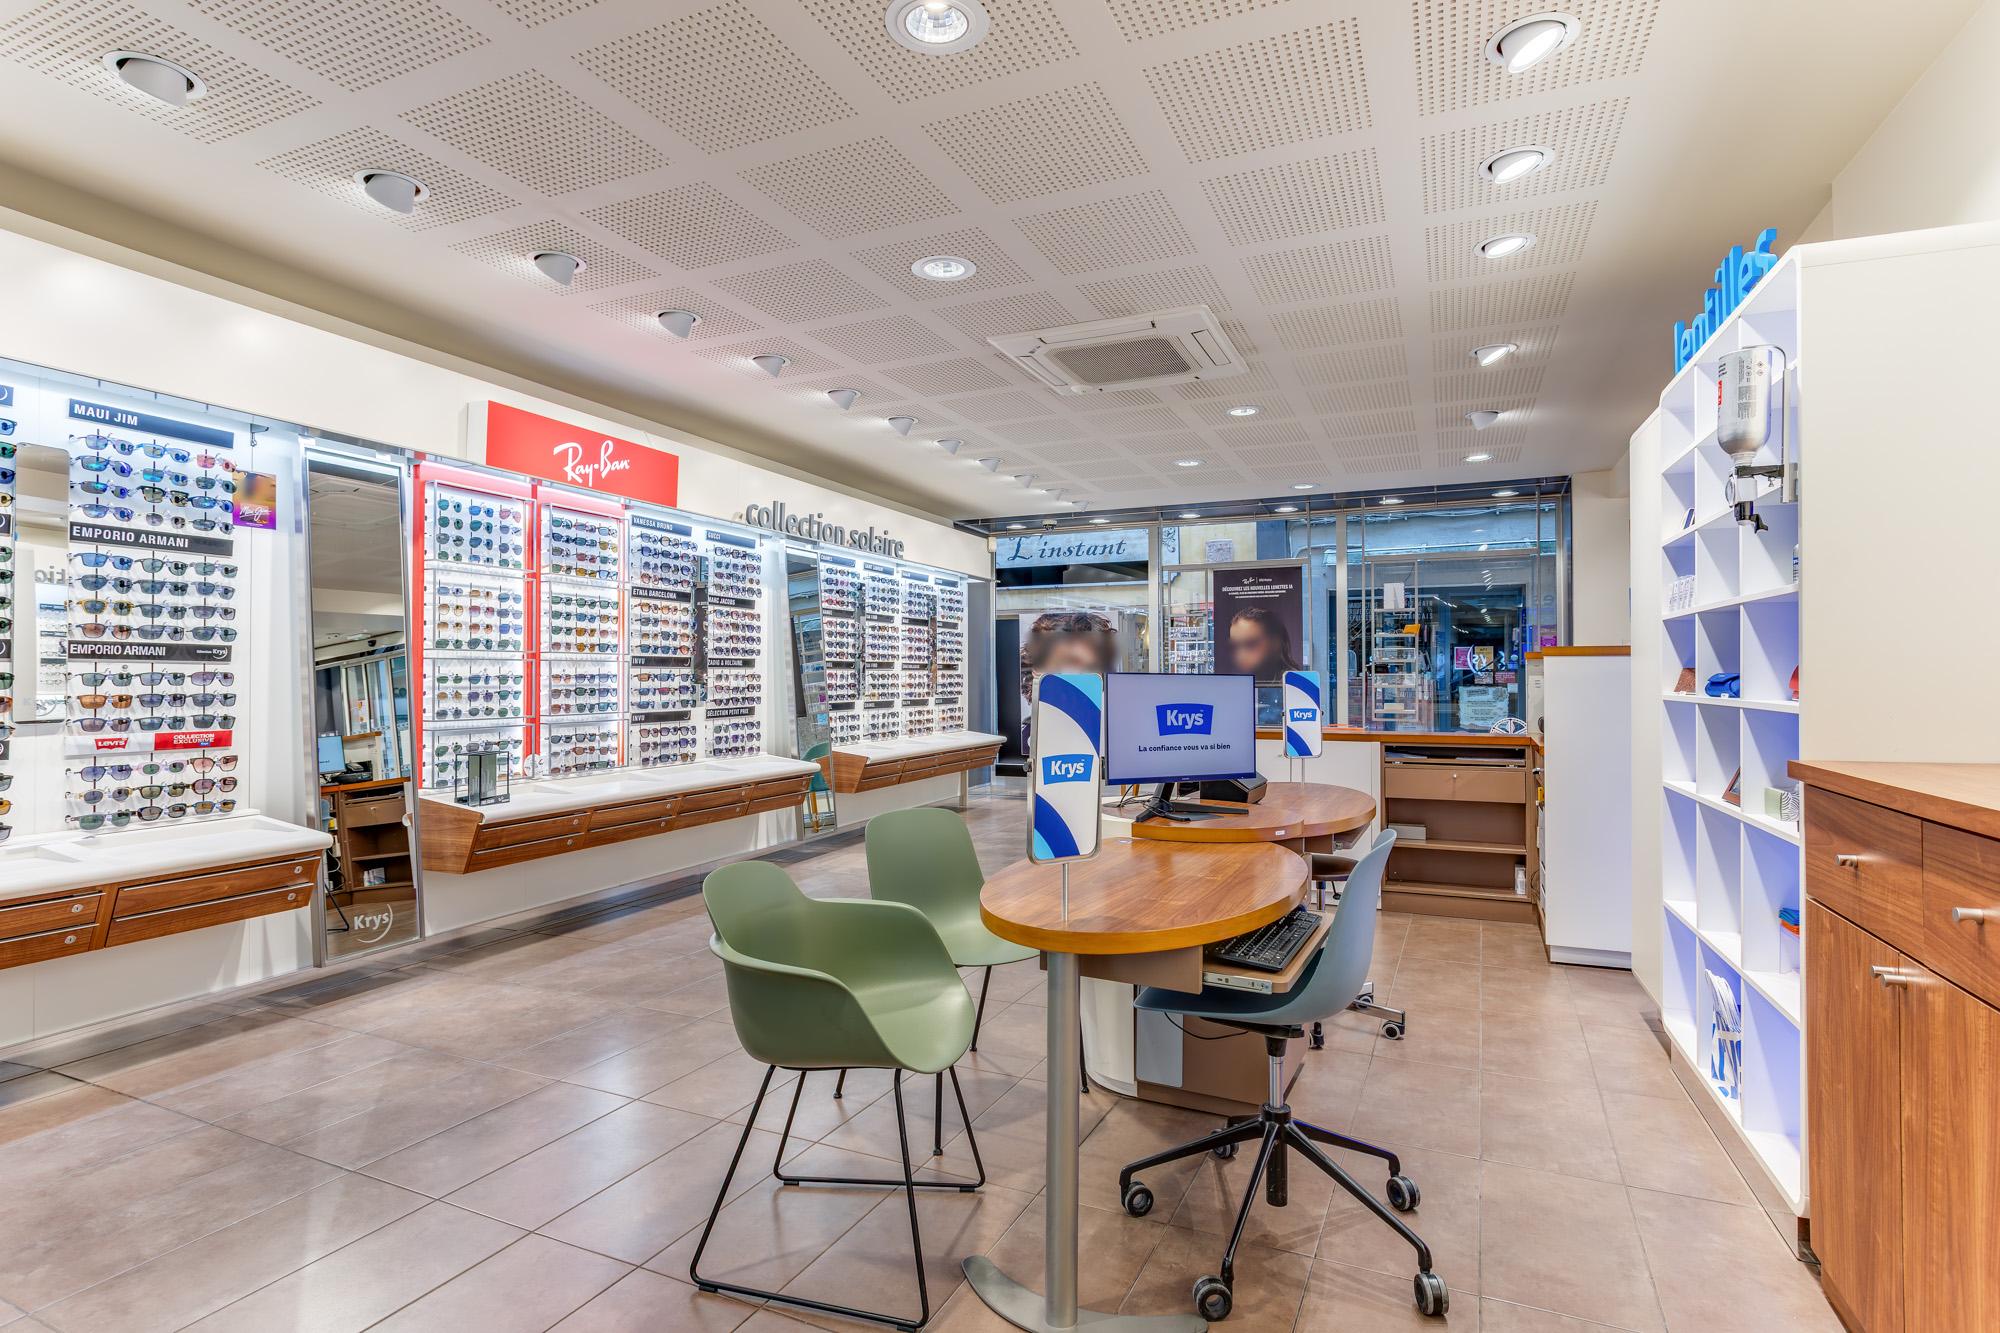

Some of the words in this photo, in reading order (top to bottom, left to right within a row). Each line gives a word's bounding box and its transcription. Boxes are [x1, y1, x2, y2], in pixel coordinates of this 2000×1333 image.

[74, 403, 110, 420] MAUI
[113, 412, 138, 426] JIM
[633, 516, 656, 528] VANESSA
[656, 521, 673, 531] BRUNO
[745, 500, 846, 546] collection
[849, 526, 904, 559] solaire
[72, 525, 135, 542] EMPORIO
[138, 533, 189, 548] ARMANI
[707, 531, 721, 540] GUCCI
[1007, 535, 1127, 561] L'instant
[632, 588, 648, 596] ETNIA
[648, 590, 677, 599] BARCELONA
[720, 598, 736, 606] JACOBS
[70, 644, 122, 655] EMPORIO
[124, 644, 166, 657] ARMANI
[212, 648, 226, 656] Krys
[1166, 709, 1204, 730] Krys
[1293, 710, 1313, 720] Krys
[1148, 744, 1182, 752] confiance
[1050, 760, 1085, 778] Krys
[353, 912, 389, 930] Krys
